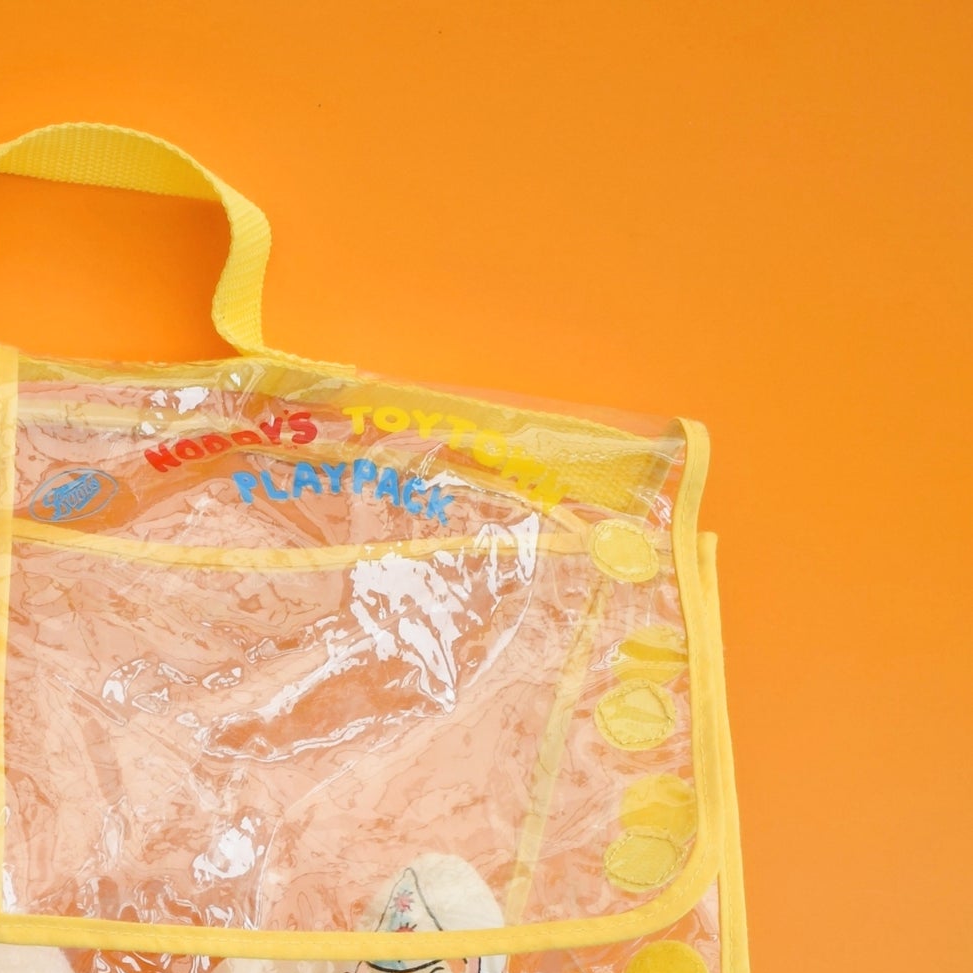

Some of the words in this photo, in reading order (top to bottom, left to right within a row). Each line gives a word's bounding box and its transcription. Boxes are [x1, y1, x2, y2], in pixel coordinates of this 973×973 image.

[144, 411, 318, 473] NODDY'S
[42, 472, 101, 521] Boots
[232, 458, 455, 526] PLAYPACK
